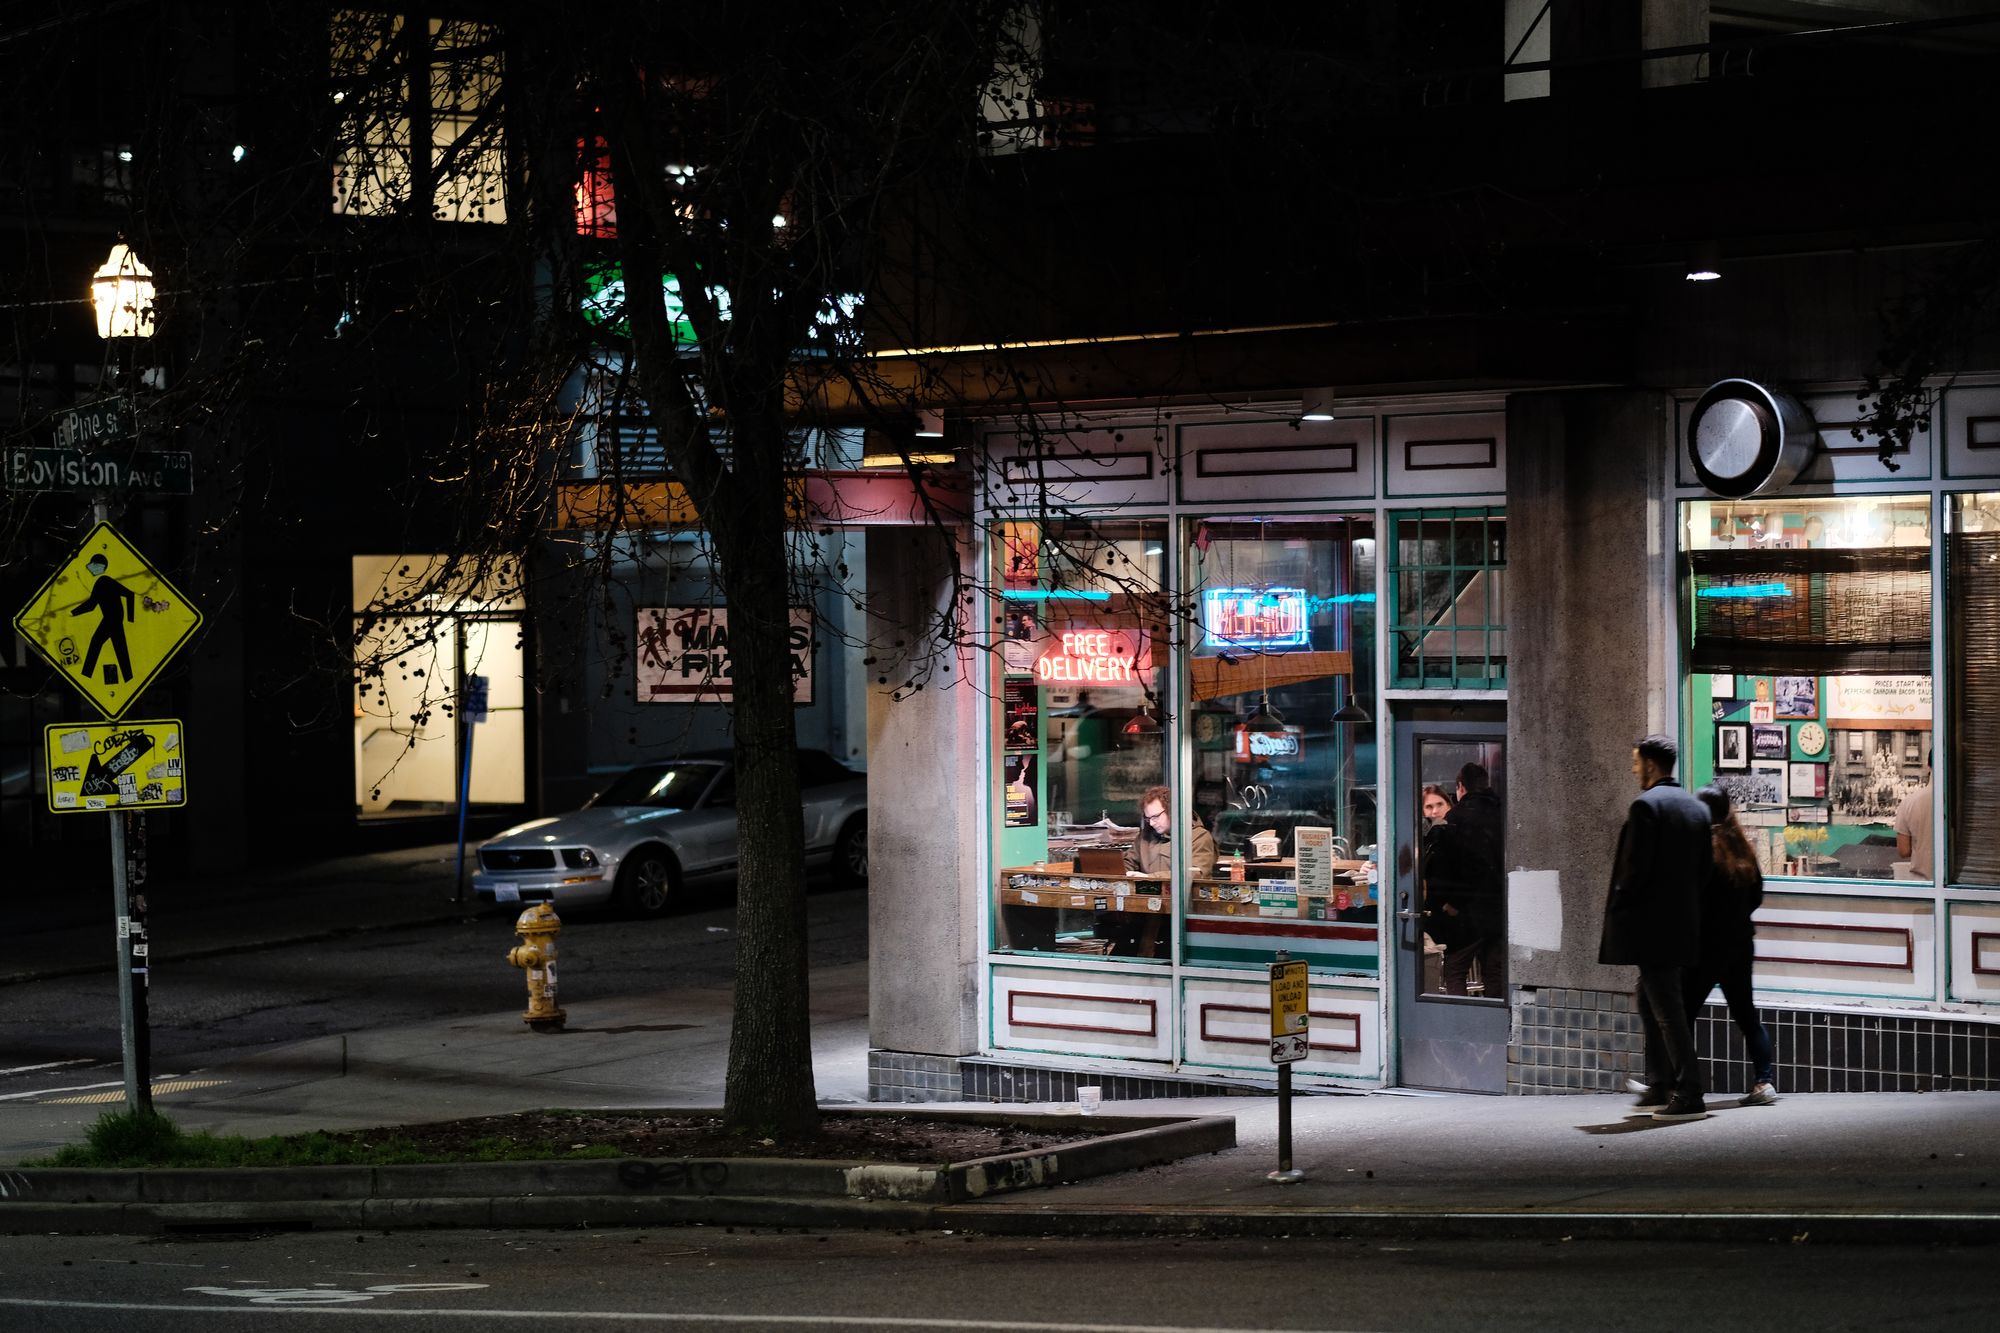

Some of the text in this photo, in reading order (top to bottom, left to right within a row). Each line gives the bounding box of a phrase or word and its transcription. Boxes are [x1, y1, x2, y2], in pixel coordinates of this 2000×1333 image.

[69, 413, 104, 443] Pine
[13, 452, 163, 490] Boylston Ave
[163, 455, 187, 469] 700
[681, 625, 809, 650] MAS
[1062, 633, 1109, 656] FREE
[681, 654, 808, 678] PIA
[1039, 656, 1134, 681] DELIVERY
[1273, 966, 1305, 978] 30 MINUTE
[1275, 980, 1305, 992] LOAD AND
[1279, 991, 1302, 1002] UNLOAD
[1282, 1003, 1298, 1013] ONLY
